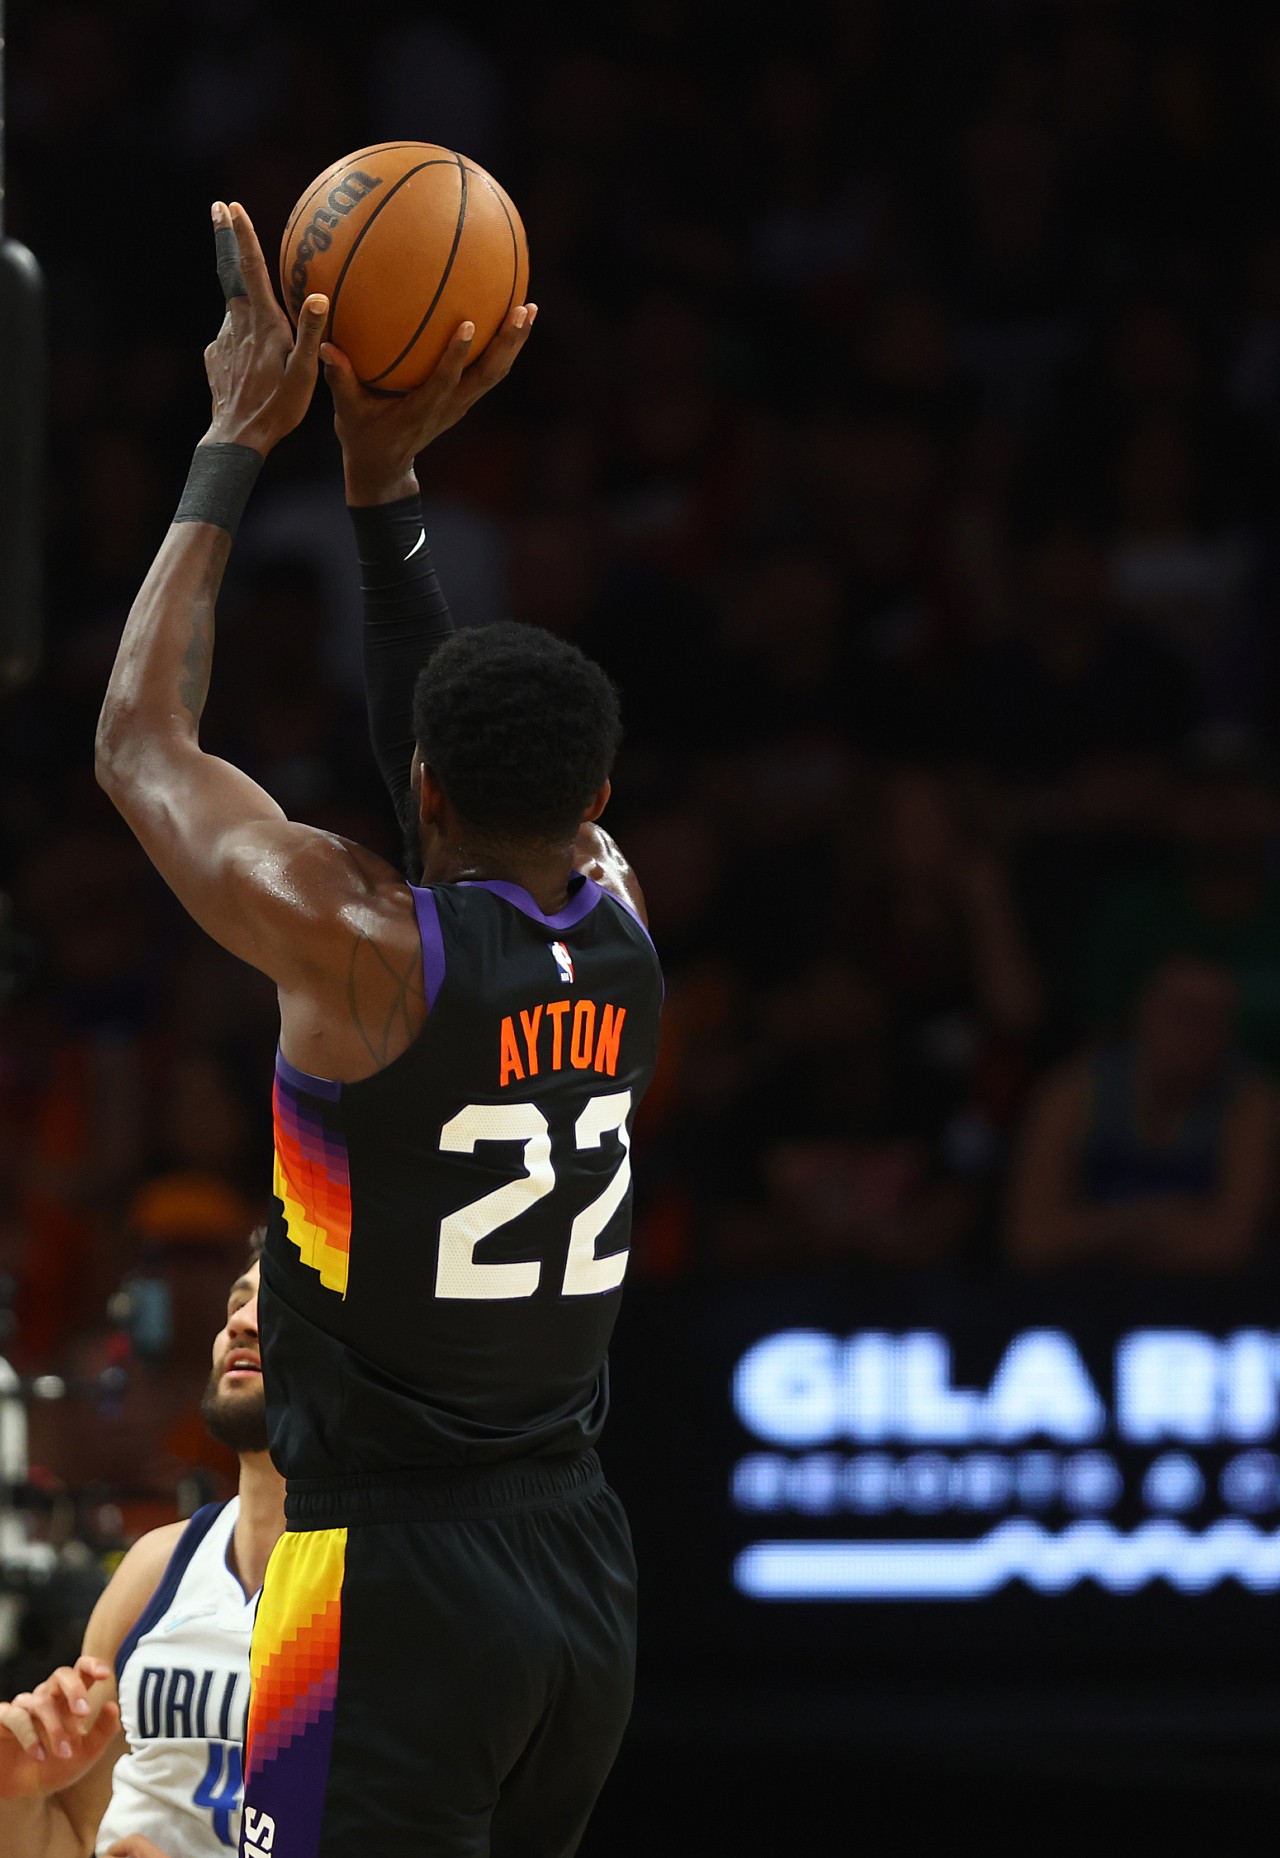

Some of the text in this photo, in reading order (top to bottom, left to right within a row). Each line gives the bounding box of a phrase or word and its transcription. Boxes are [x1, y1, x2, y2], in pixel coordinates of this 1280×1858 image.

[500, 1000, 626, 1087] AYTON
[434, 1090, 632, 1299] 22
[1114, 1325, 1280, 1445] RI
[137, 1666, 249, 1741] DALL
